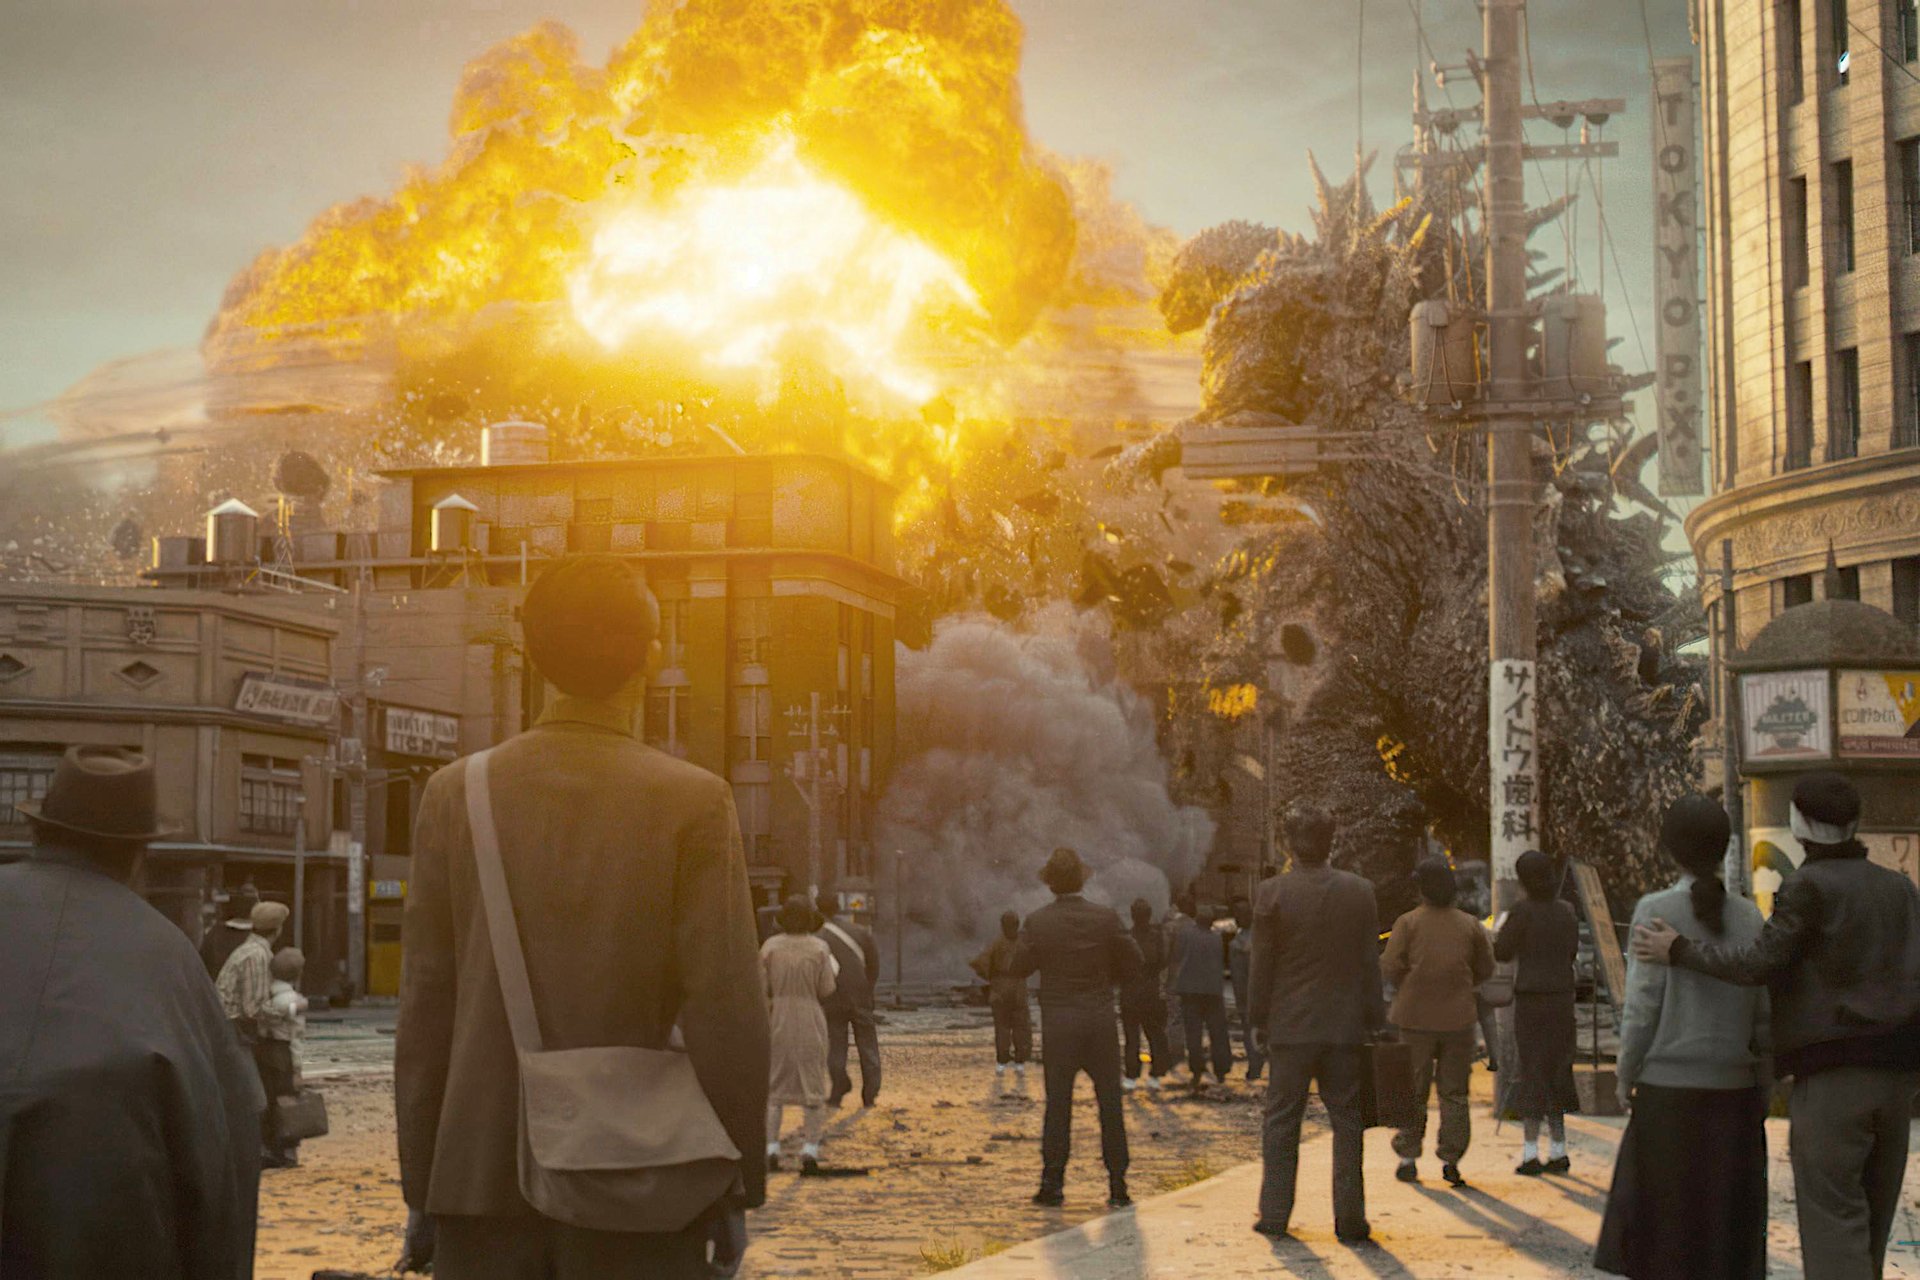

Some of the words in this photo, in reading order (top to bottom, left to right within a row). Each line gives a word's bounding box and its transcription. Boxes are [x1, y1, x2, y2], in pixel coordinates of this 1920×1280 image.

[1658, 92, 1693, 327] TOKYO
[1503, 664, 1538, 842] サイトウ歯科
